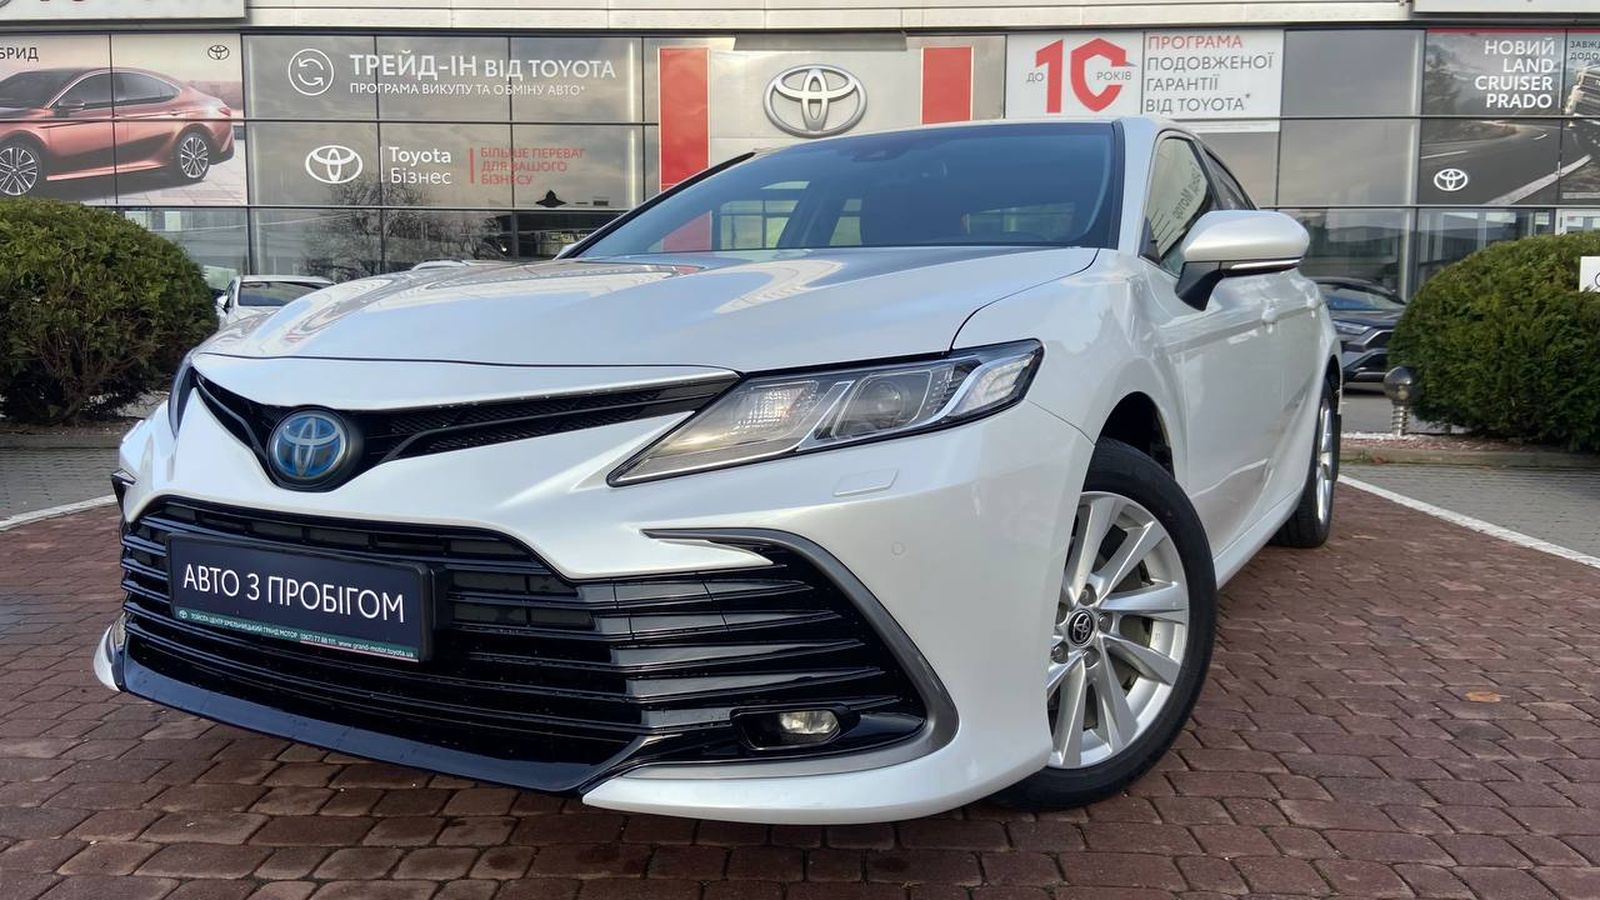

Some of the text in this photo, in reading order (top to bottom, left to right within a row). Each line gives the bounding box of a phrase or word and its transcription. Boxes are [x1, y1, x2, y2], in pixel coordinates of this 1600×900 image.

[1148, 34, 1243, 50] ПРОГРАМА
[1484, 37, 1555, 56] НОВИЙ
[350, 49, 616, 81] ТРЕЙД-ІН ВІД TOYOTA
[1147, 52, 1274, 72] ПОДОВЖЕНОЇ
[1503, 58, 1554, 73] LAND
[1026, 72, 1045, 83] ДО
[1096, 70, 1132, 82] РОКІВ
[1146, 74, 1220, 92] ГАРАНТІЇ
[1475, 75, 1553, 91] CRUISER
[350, 83, 419, 95] ПРОГРАМА
[422, 84, 472, 95] ВИКУПУ
[475, 84, 491, 95] ТА
[494, 84, 544, 96] ОБМІНУ
[1146, 98, 1173, 114] ВІД
[1486, 93, 1552, 109] PRADO
[389, 146, 452, 166] Toyota
[532, 147, 586, 158] ПЕРЕВАГ
[481, 161, 509, 172] ДЛЯ
[390, 167, 452, 185] Бізнес
[183, 563, 405, 623] АВТО З ПРОБІГОМ
